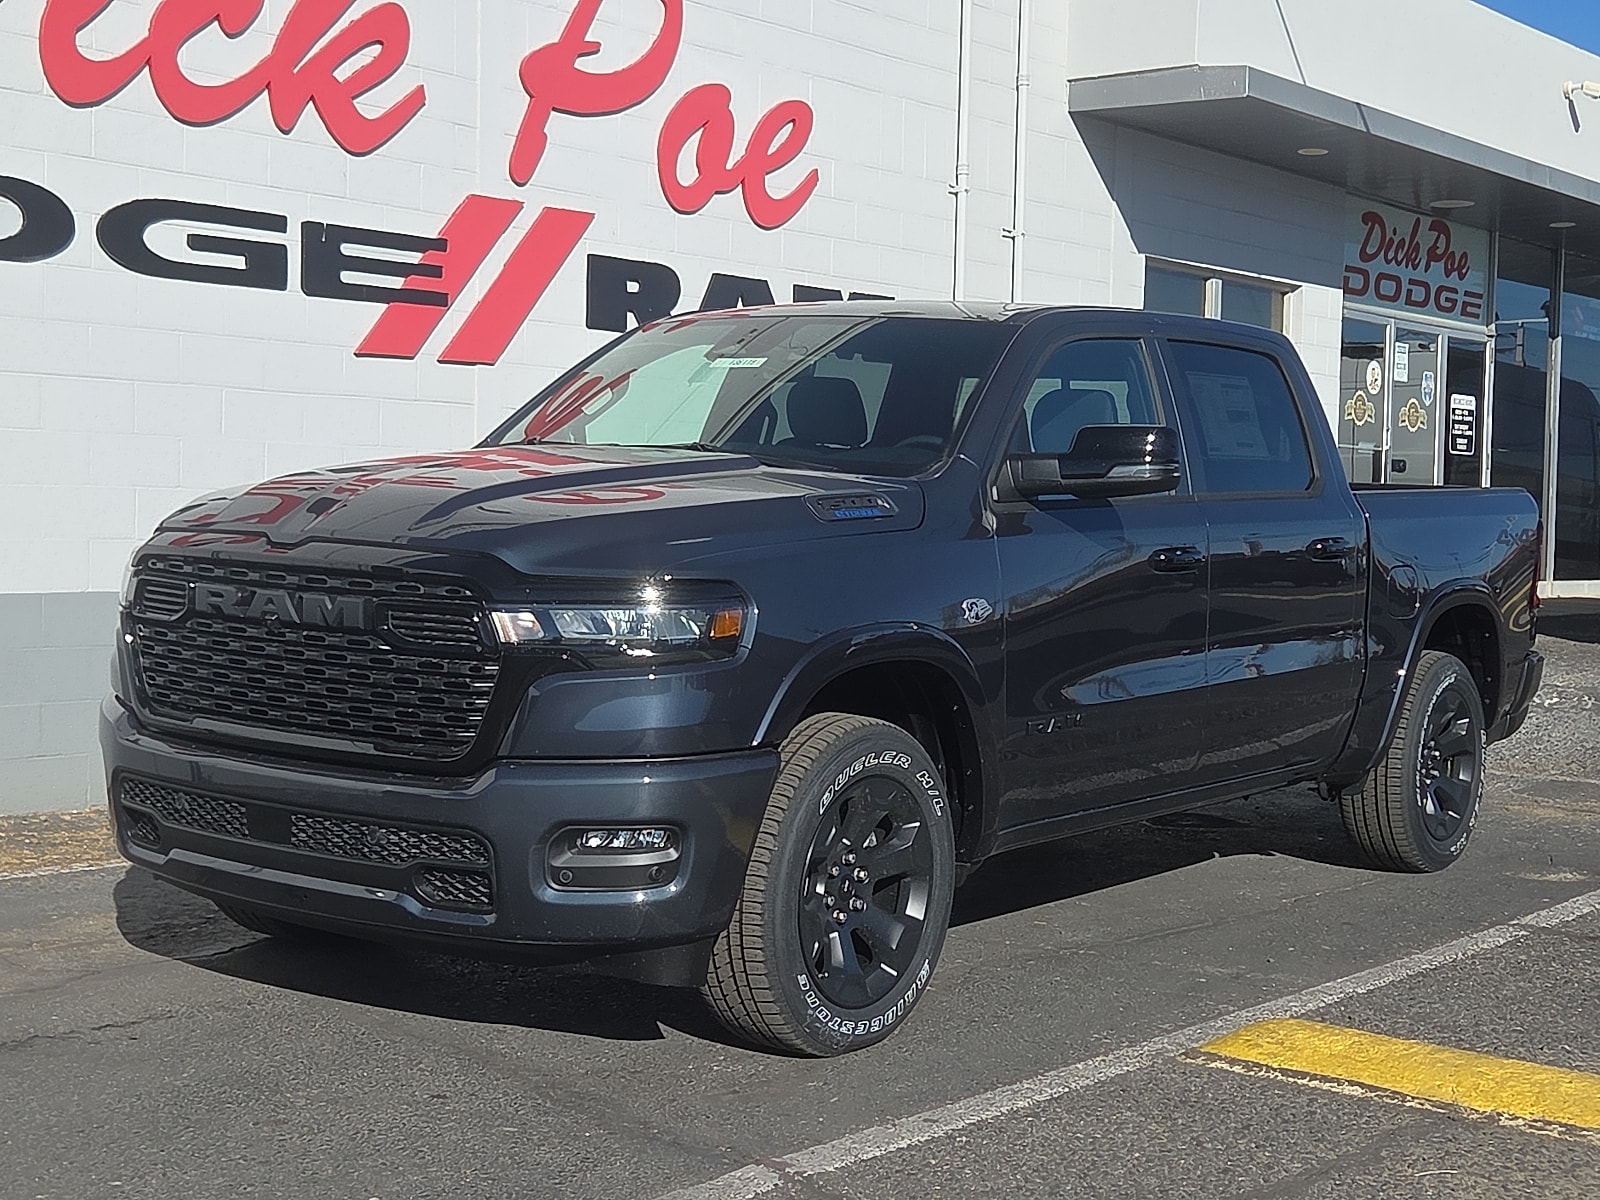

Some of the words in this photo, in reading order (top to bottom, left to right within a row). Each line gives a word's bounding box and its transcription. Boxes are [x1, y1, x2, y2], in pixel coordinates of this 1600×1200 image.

[509, 0, 818, 229] Poe
[1359, 211, 1421, 271] Dick
[1424, 219, 1470, 281] Poe
[1343, 264, 1483, 320] DODGE
[194, 581, 368, 630] RAM
[819, 751, 912, 815] DUELER
[796, 958, 932, 1036] BRIDGESTONE
